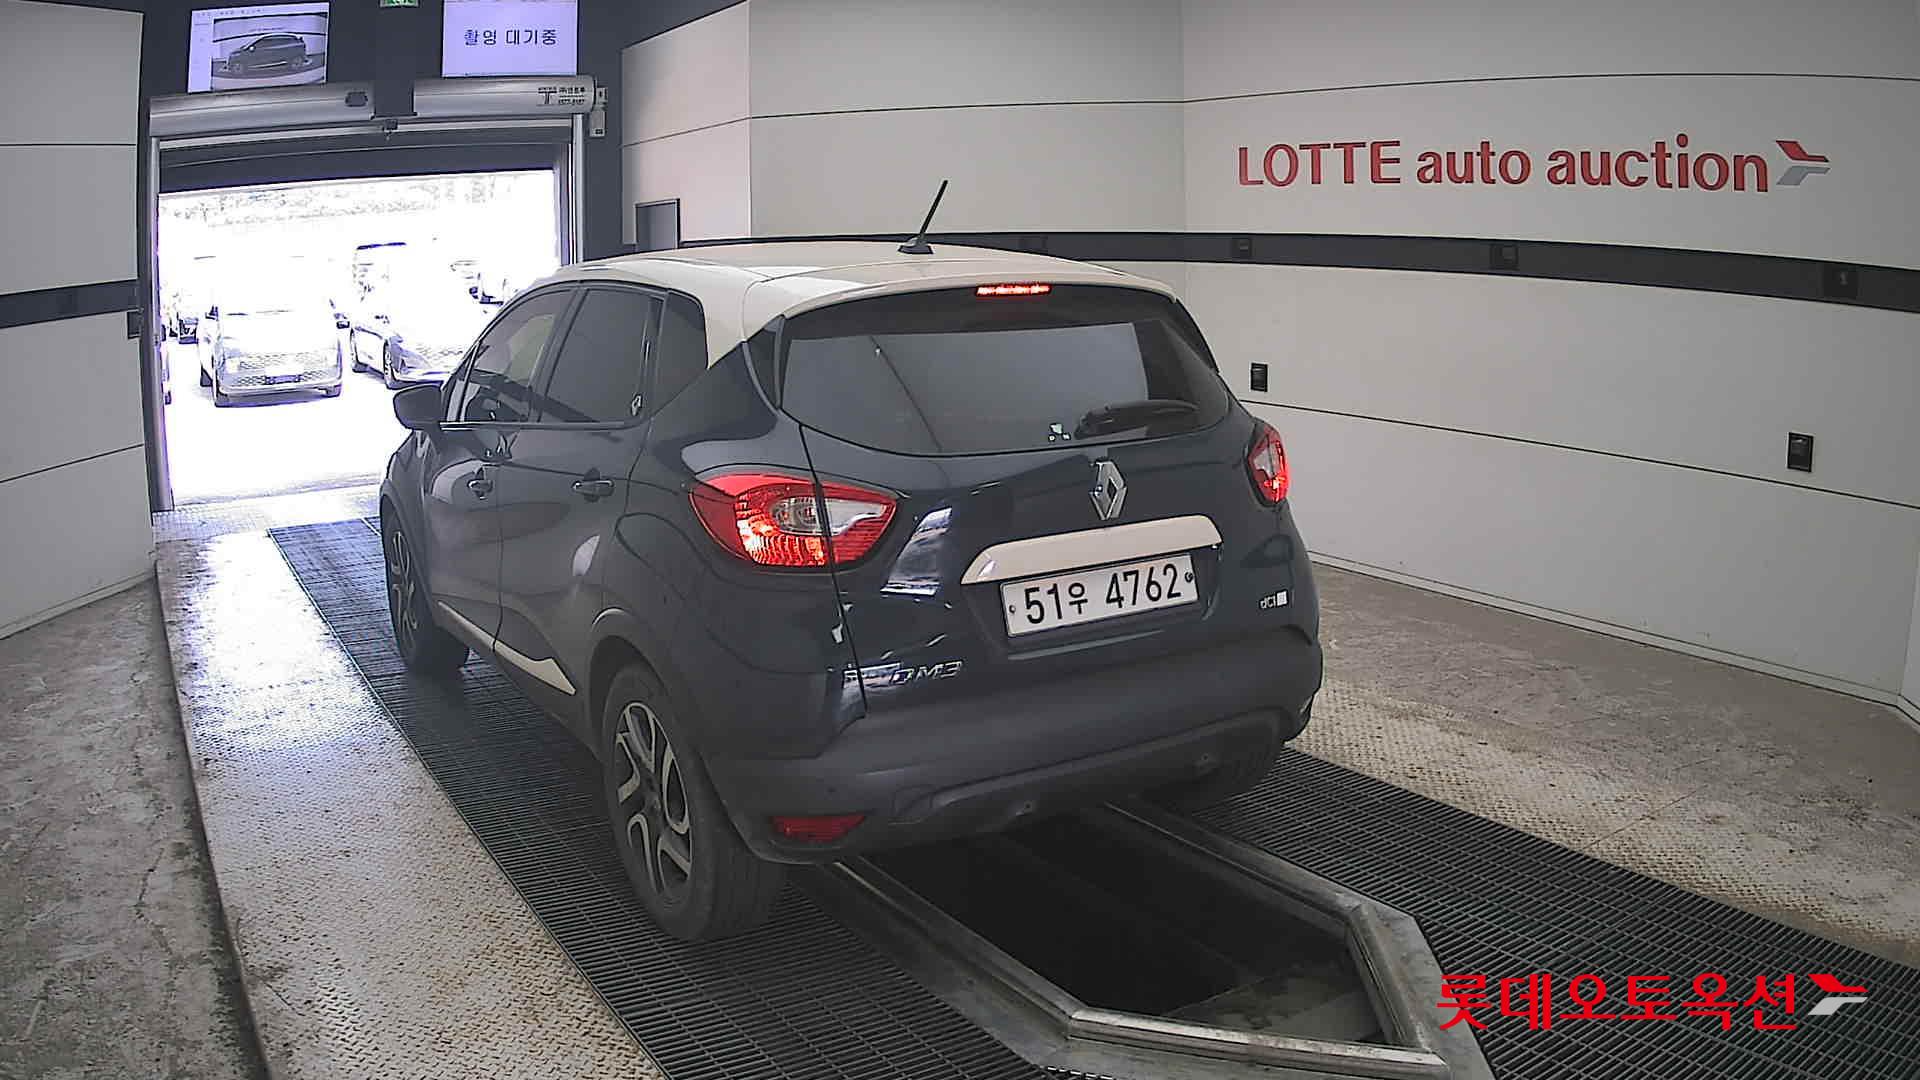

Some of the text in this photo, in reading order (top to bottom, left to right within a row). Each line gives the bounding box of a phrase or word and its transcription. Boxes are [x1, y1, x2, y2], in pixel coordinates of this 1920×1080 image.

[505, 29, 557, 46] 대기중
[1238, 133, 1769, 193] LOTTE auto auction
[1023, 563, 1182, 624] 51우 4762
